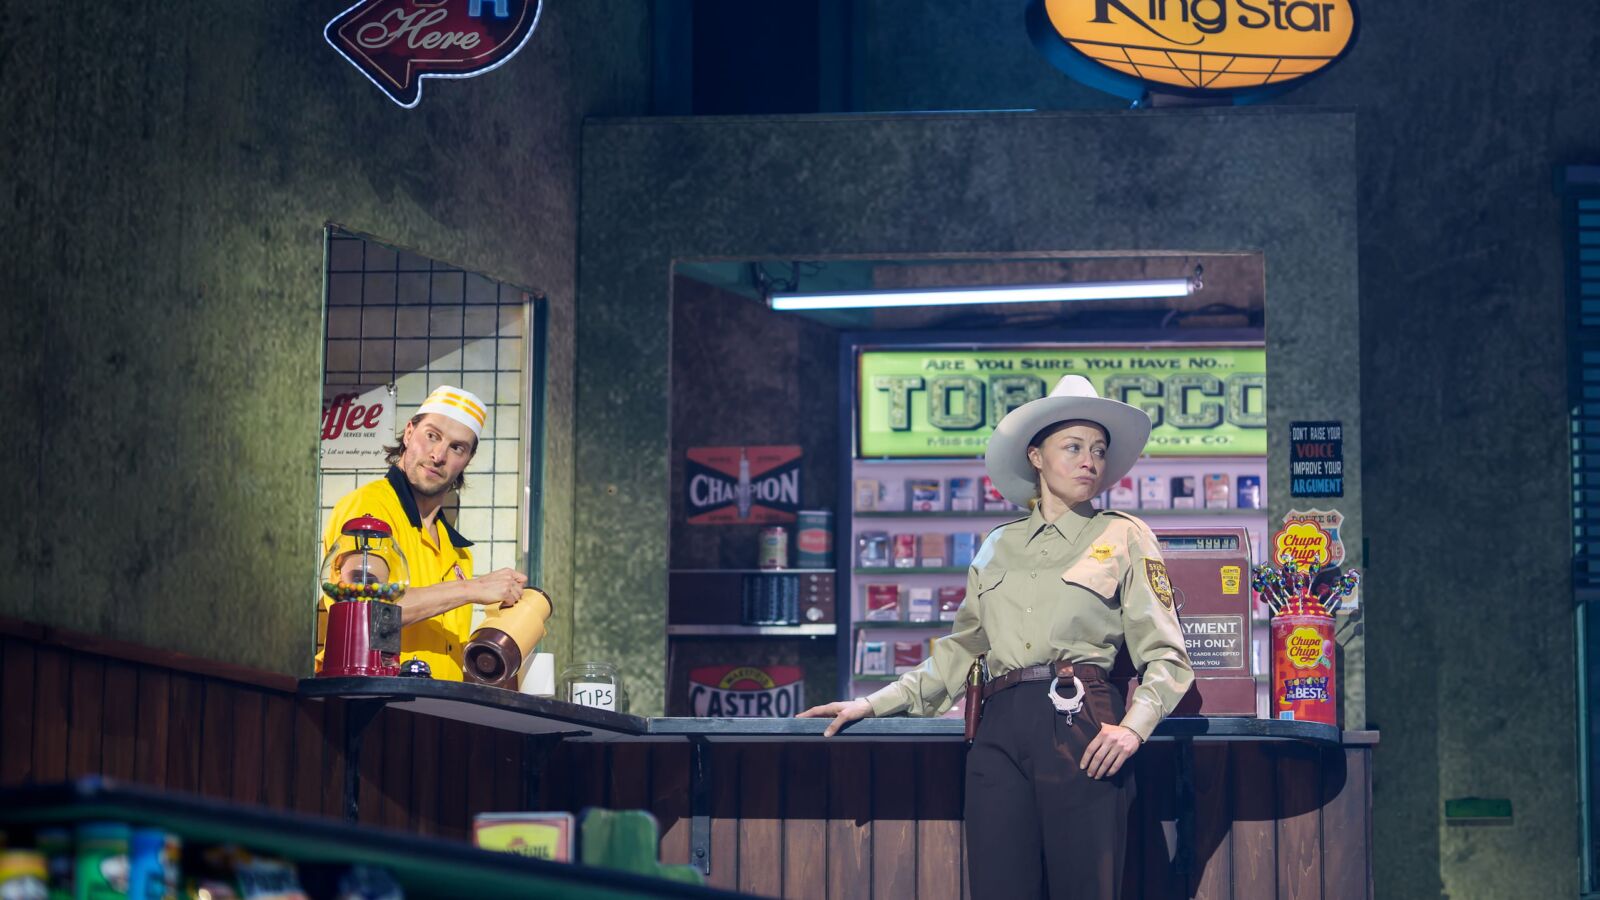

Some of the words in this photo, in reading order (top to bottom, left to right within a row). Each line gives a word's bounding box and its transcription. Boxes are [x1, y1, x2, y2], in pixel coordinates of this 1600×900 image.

[1238, 0, 1335, 32] Star
[357, 8, 481, 50] Here
[925, 359, 965, 370] ARE
[975, 359, 1013, 370] YOU
[1021, 359, 1074, 370] SURE
[1084, 358, 1122, 369] YOU
[1130, 358, 1180, 369] HAVE
[874, 372, 1266, 432] TOBCCO
[1310, 427, 1326, 440] RAISE
[1327, 426, 1341, 440] YOUR
[1296, 443, 1335, 458] VOICE
[1293, 461, 1322, 475] IMPROVE
[1323, 461, 1342, 475] YOUR
[1293, 478, 1341, 493] ARGUMENT
[1283, 534, 1323, 550] Chupa
[1181, 622, 1238, 634] YMENT
[1185, 639, 1201, 648] SH
[1204, 639, 1236, 648] ONLY
[1291, 636, 1321, 649] Chupa
[1289, 646, 1320, 662] Chups
[575, 689, 613, 706] TIPS
[1295, 687, 1323, 699] BEST
